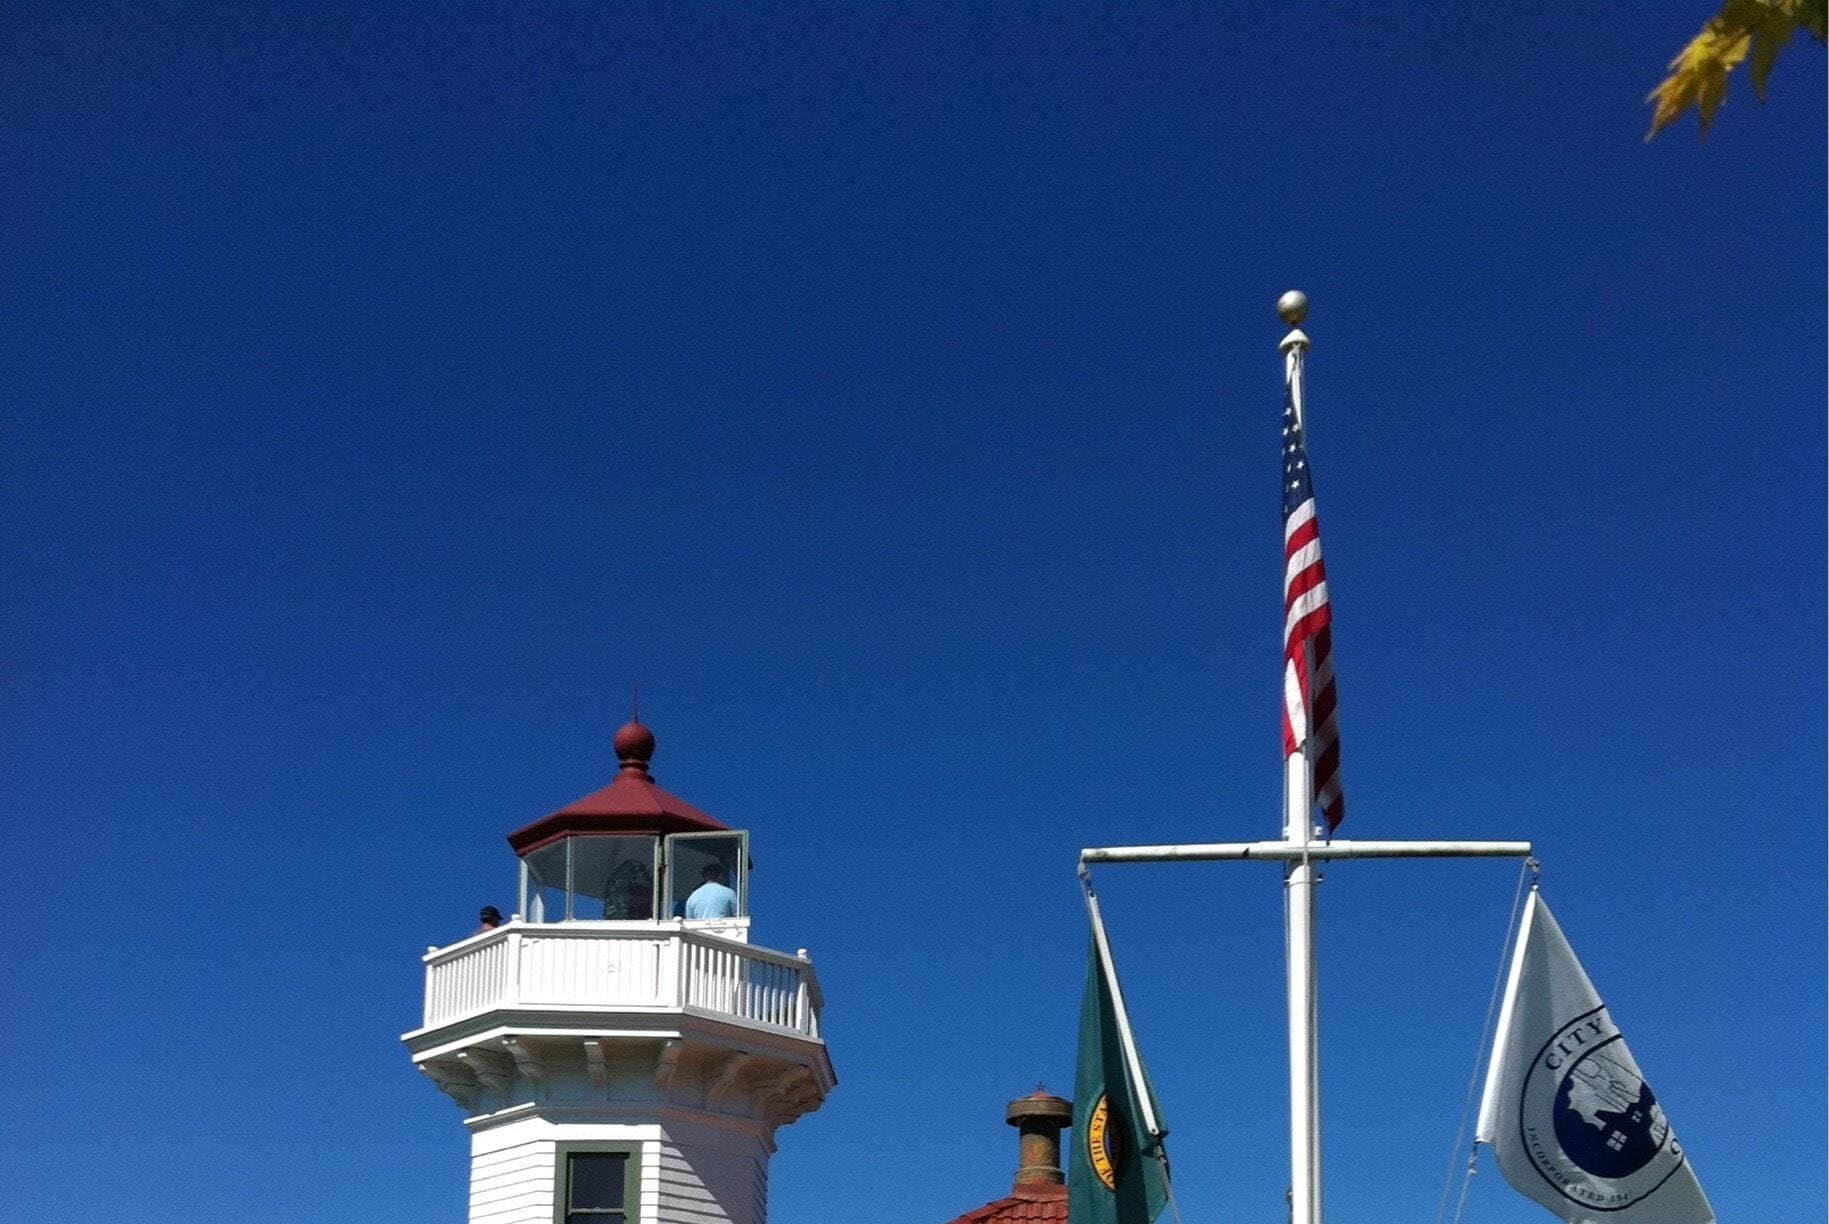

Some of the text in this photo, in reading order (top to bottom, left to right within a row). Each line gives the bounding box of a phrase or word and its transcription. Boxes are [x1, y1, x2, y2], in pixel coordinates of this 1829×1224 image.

[1544, 1017, 1603, 1071] CITY
[1092, 1136, 1105, 1166] THE
[1528, 1128, 1605, 1202] INCORPORATED
